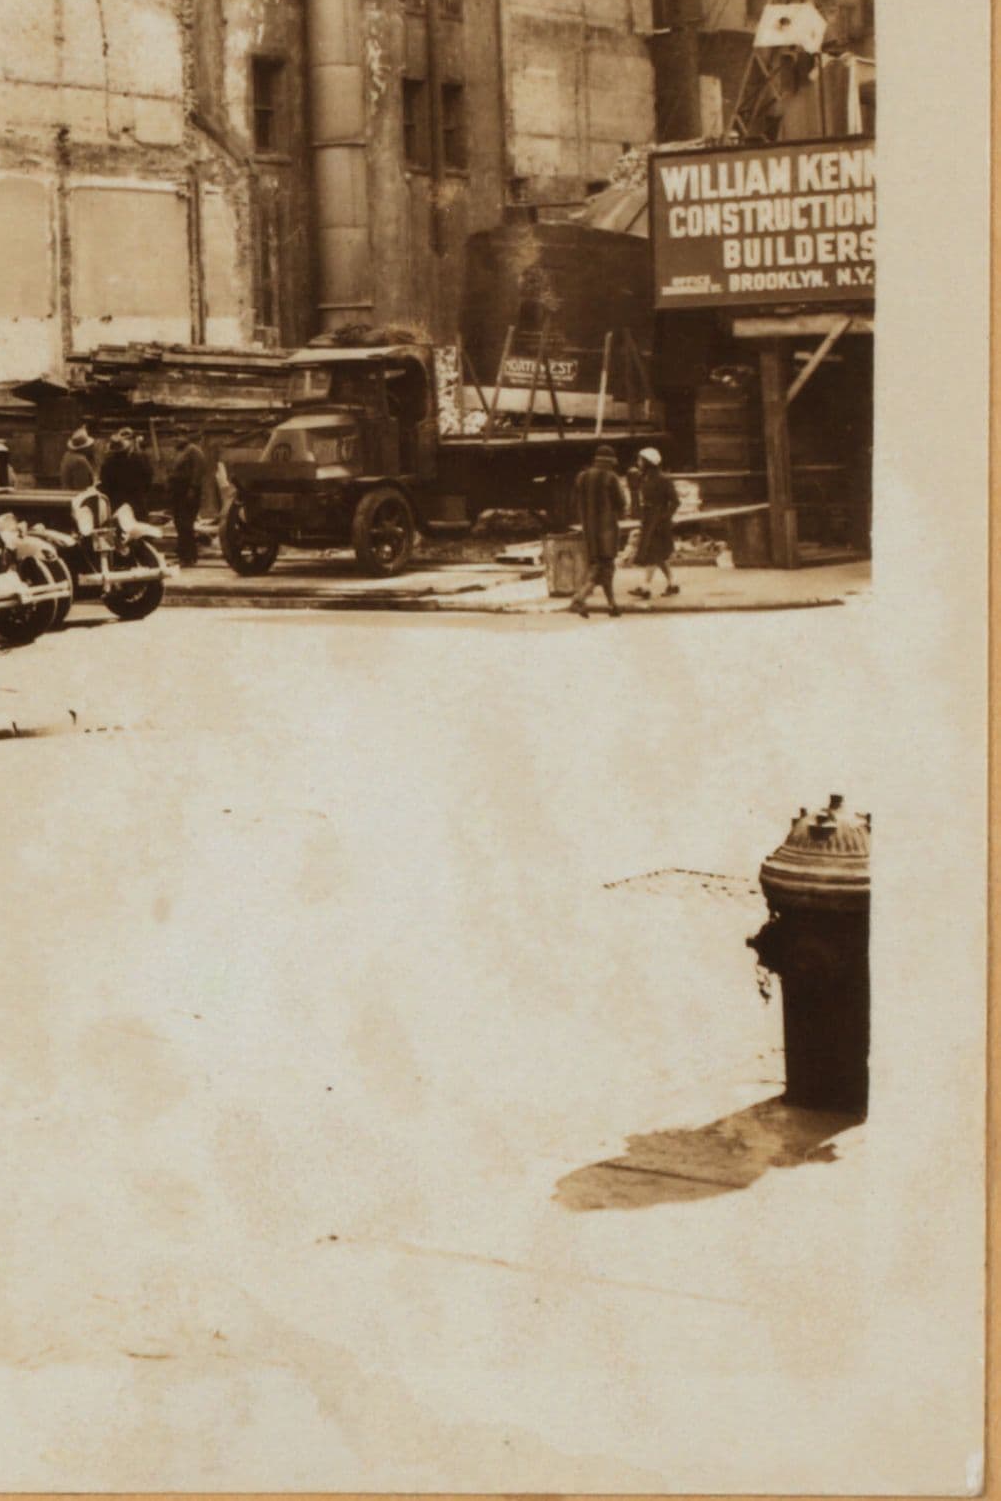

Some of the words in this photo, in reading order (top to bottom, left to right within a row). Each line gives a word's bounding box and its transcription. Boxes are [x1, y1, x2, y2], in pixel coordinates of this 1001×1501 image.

[661, 158, 790, 201] WILLIAM
[670, 192, 874, 237] CONSTRUCTION
[724, 231, 876, 268] BUILDERS
[836, 267, 874, 286] N.Y.
